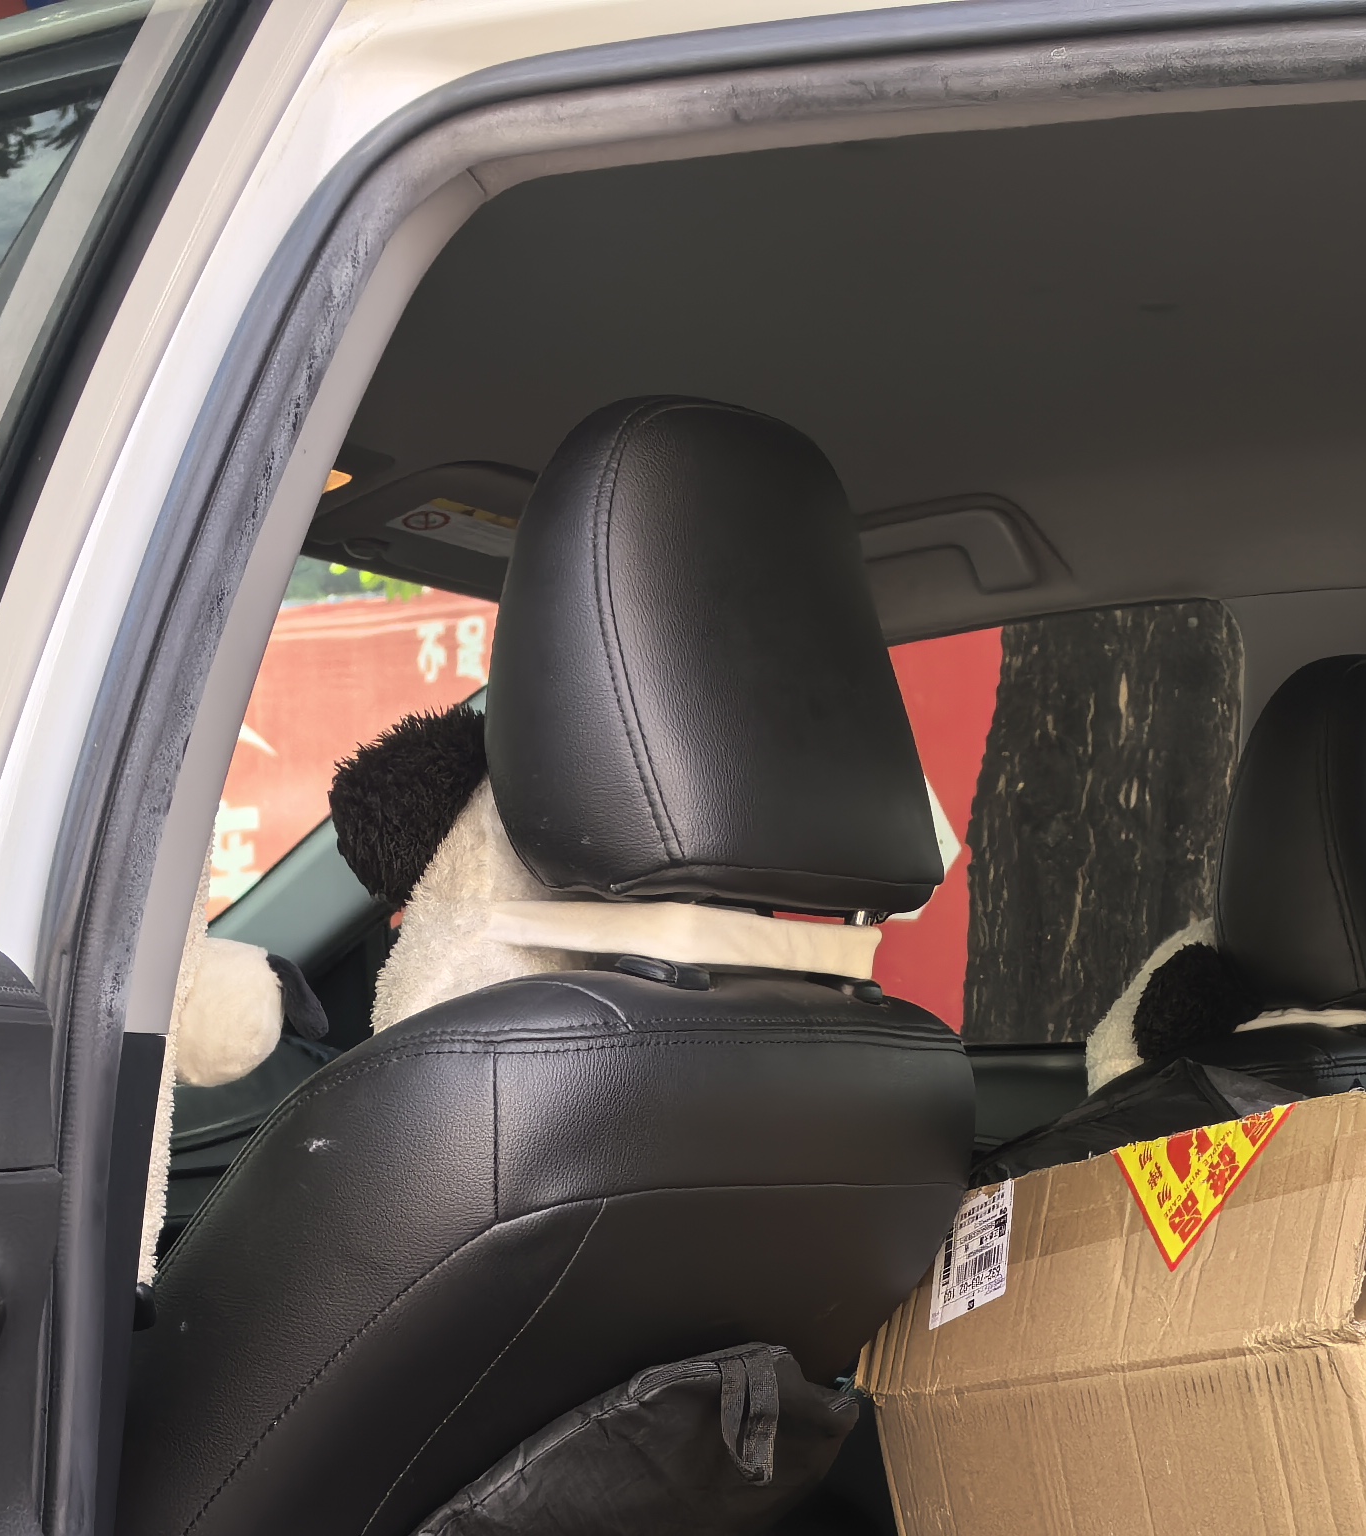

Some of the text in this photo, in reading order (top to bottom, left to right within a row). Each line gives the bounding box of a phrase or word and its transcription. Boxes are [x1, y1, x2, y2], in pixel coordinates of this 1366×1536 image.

[1128, 1141, 1172, 1209] 勿摔勿
[1163, 1130, 1233, 1219] HANDLE WITH CARE
